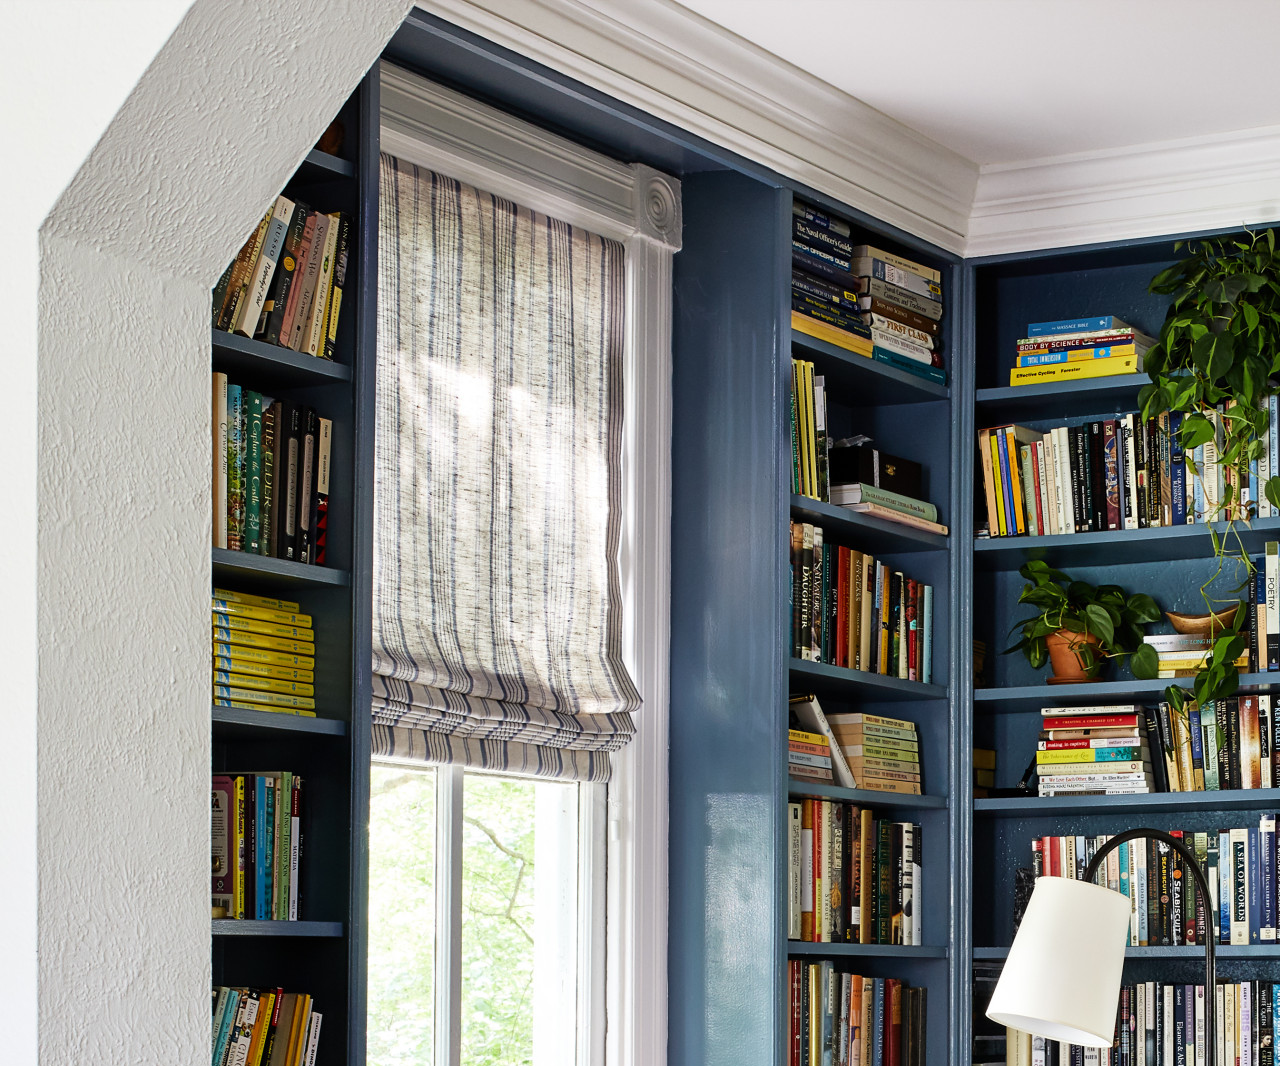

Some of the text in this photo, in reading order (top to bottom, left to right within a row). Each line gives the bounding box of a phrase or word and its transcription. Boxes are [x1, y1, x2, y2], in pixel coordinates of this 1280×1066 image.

[269, 224, 283, 258] RUSSO
[838, 241, 853, 253] Guide
[230, 287, 241, 311] OCEAN
[887, 320, 929, 343] FIRST CLASS
[1051, 340, 1080, 348] SCIENCE
[249, 421, 262, 458] Capture
[263, 412, 275, 507] THE ELDER
[250, 476, 260, 507] Castle
[802, 566, 810, 629] DAUGHTER
[1238, 870, 1245, 884] OF
[1174, 880, 1182, 933] SEABISCUIT
[1242, 1010, 1250, 1032] IRIS
